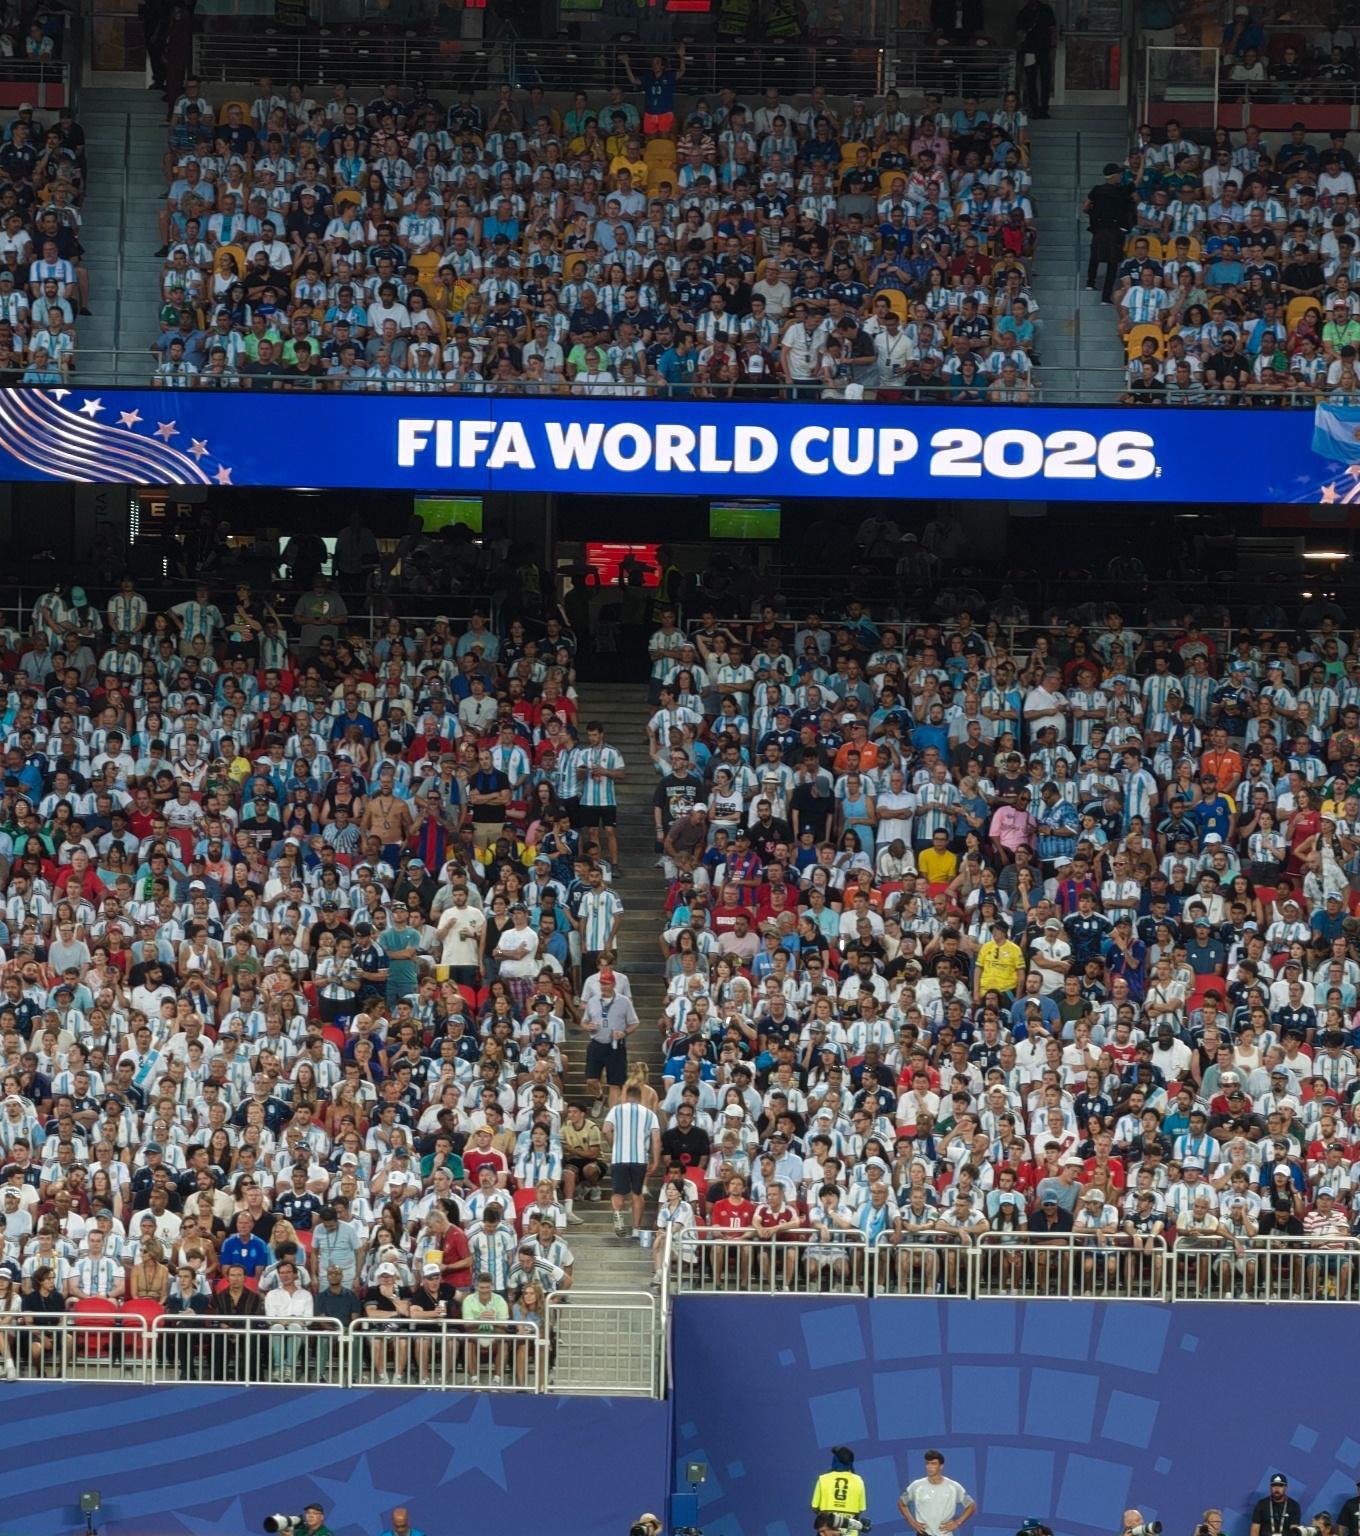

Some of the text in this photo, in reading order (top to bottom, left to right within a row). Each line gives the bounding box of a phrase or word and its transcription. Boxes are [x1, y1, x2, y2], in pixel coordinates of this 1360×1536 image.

[398, 420, 1155, 479] FIFA WORLD CUP 2026
